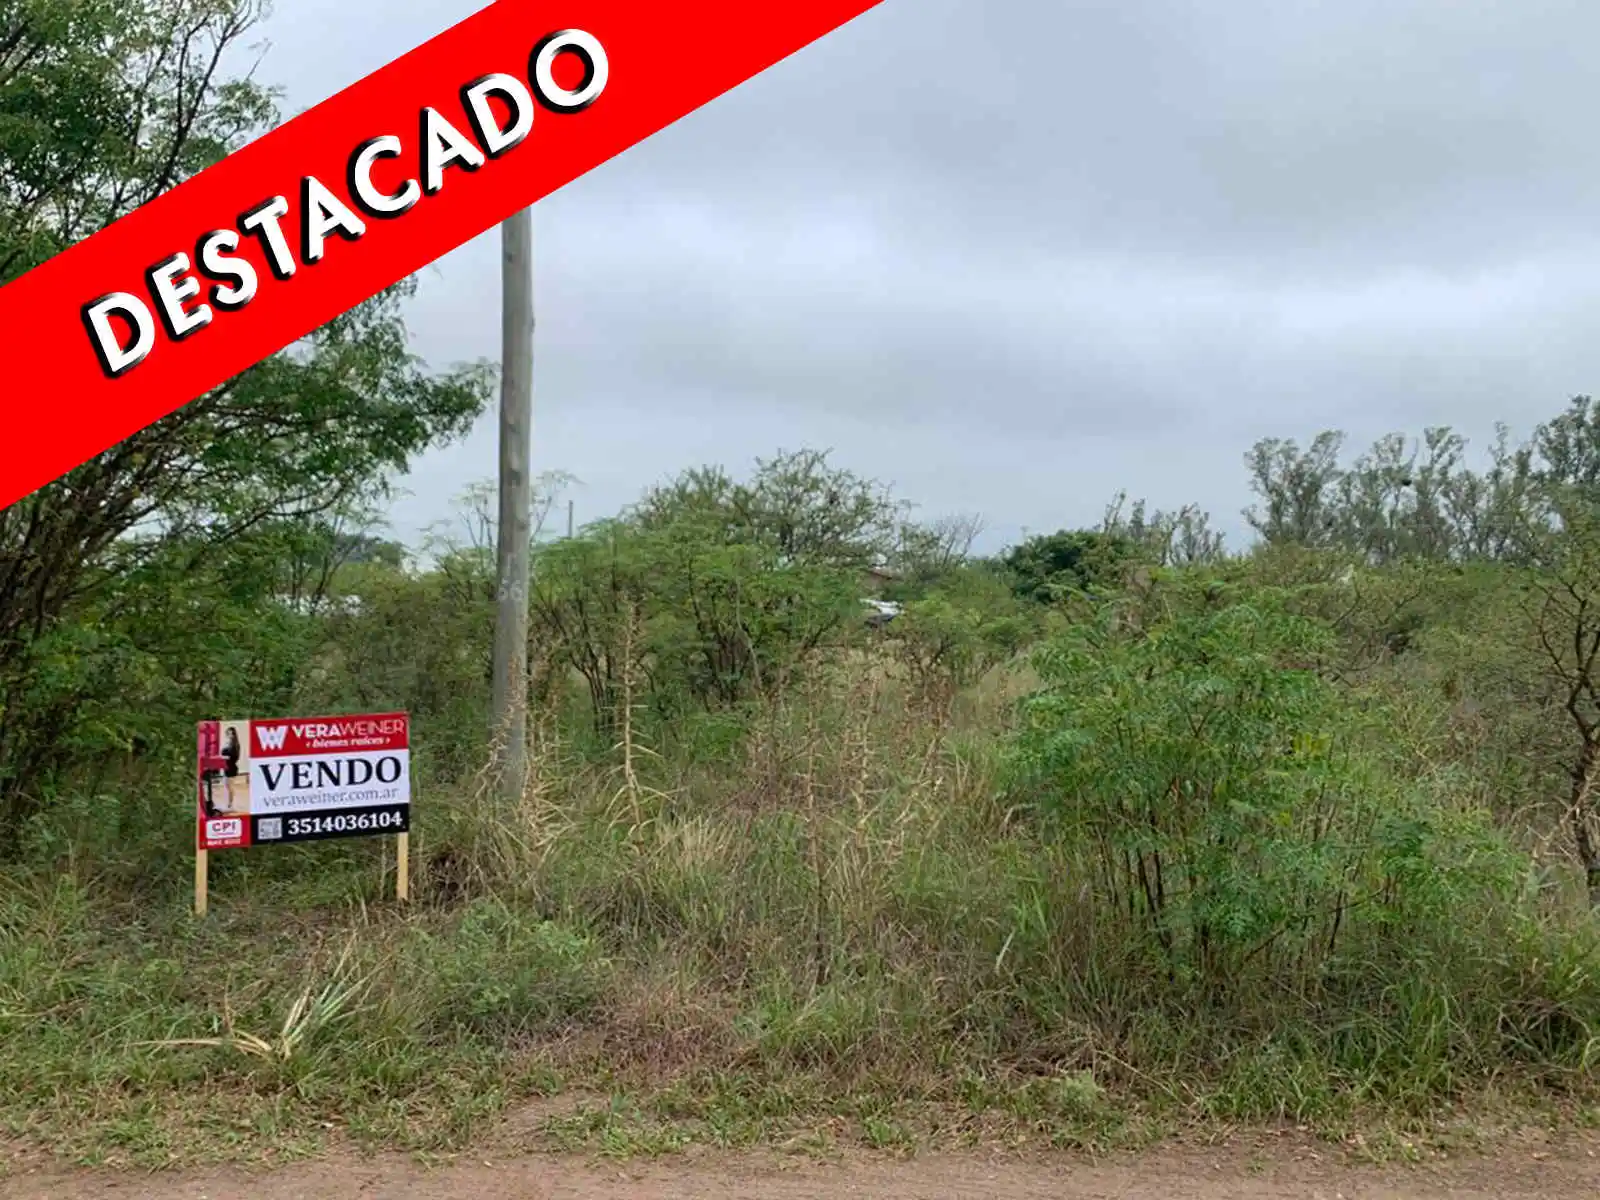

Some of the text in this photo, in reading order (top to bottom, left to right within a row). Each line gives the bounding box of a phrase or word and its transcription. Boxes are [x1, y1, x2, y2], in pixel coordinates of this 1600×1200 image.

[291, 719, 405, 739] VERAWEINER
[259, 757, 401, 790] VENDO
[263, 788, 398, 807] veraweiner.com.ar
[288, 811, 403, 835] 3514036104
